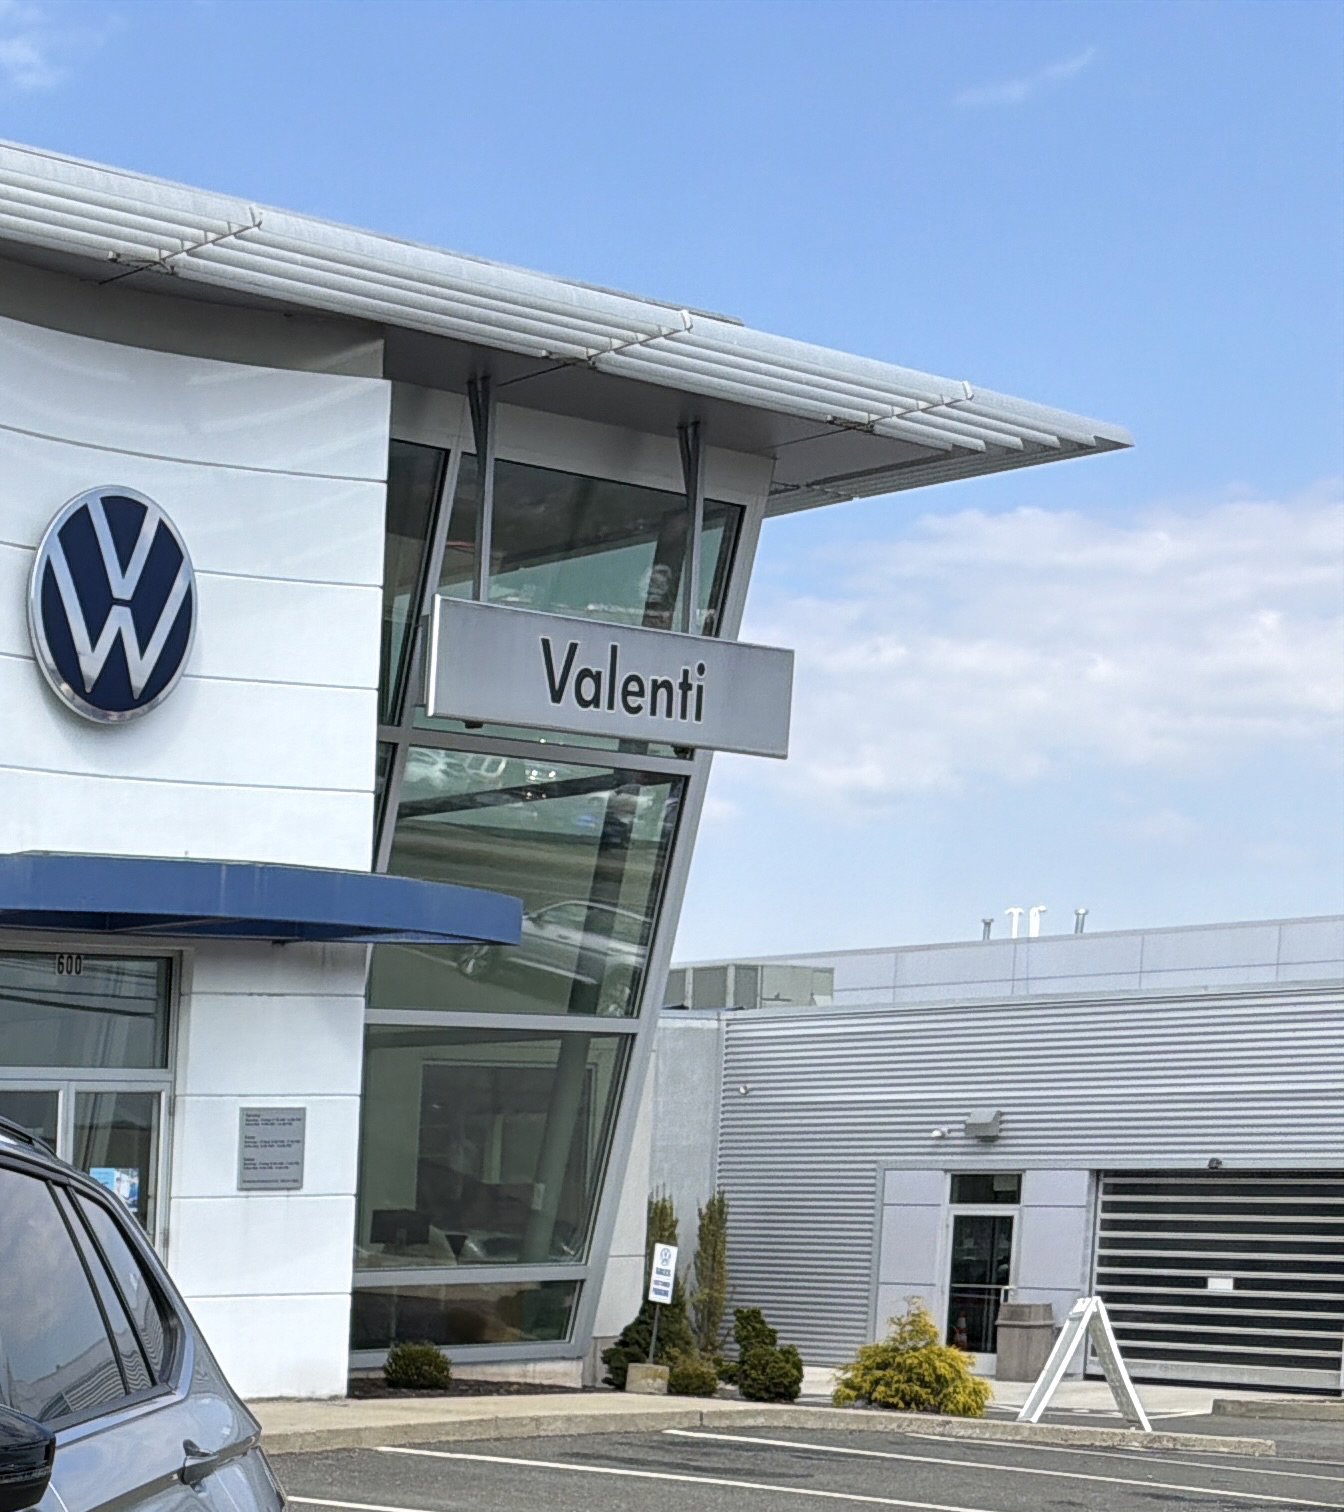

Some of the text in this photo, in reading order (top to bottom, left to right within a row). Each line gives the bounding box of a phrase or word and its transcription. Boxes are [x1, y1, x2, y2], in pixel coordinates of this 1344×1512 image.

[33, 489, 196, 714] VW
[539, 636, 706, 723] Valenti
[57, 954, 82, 975] 600
